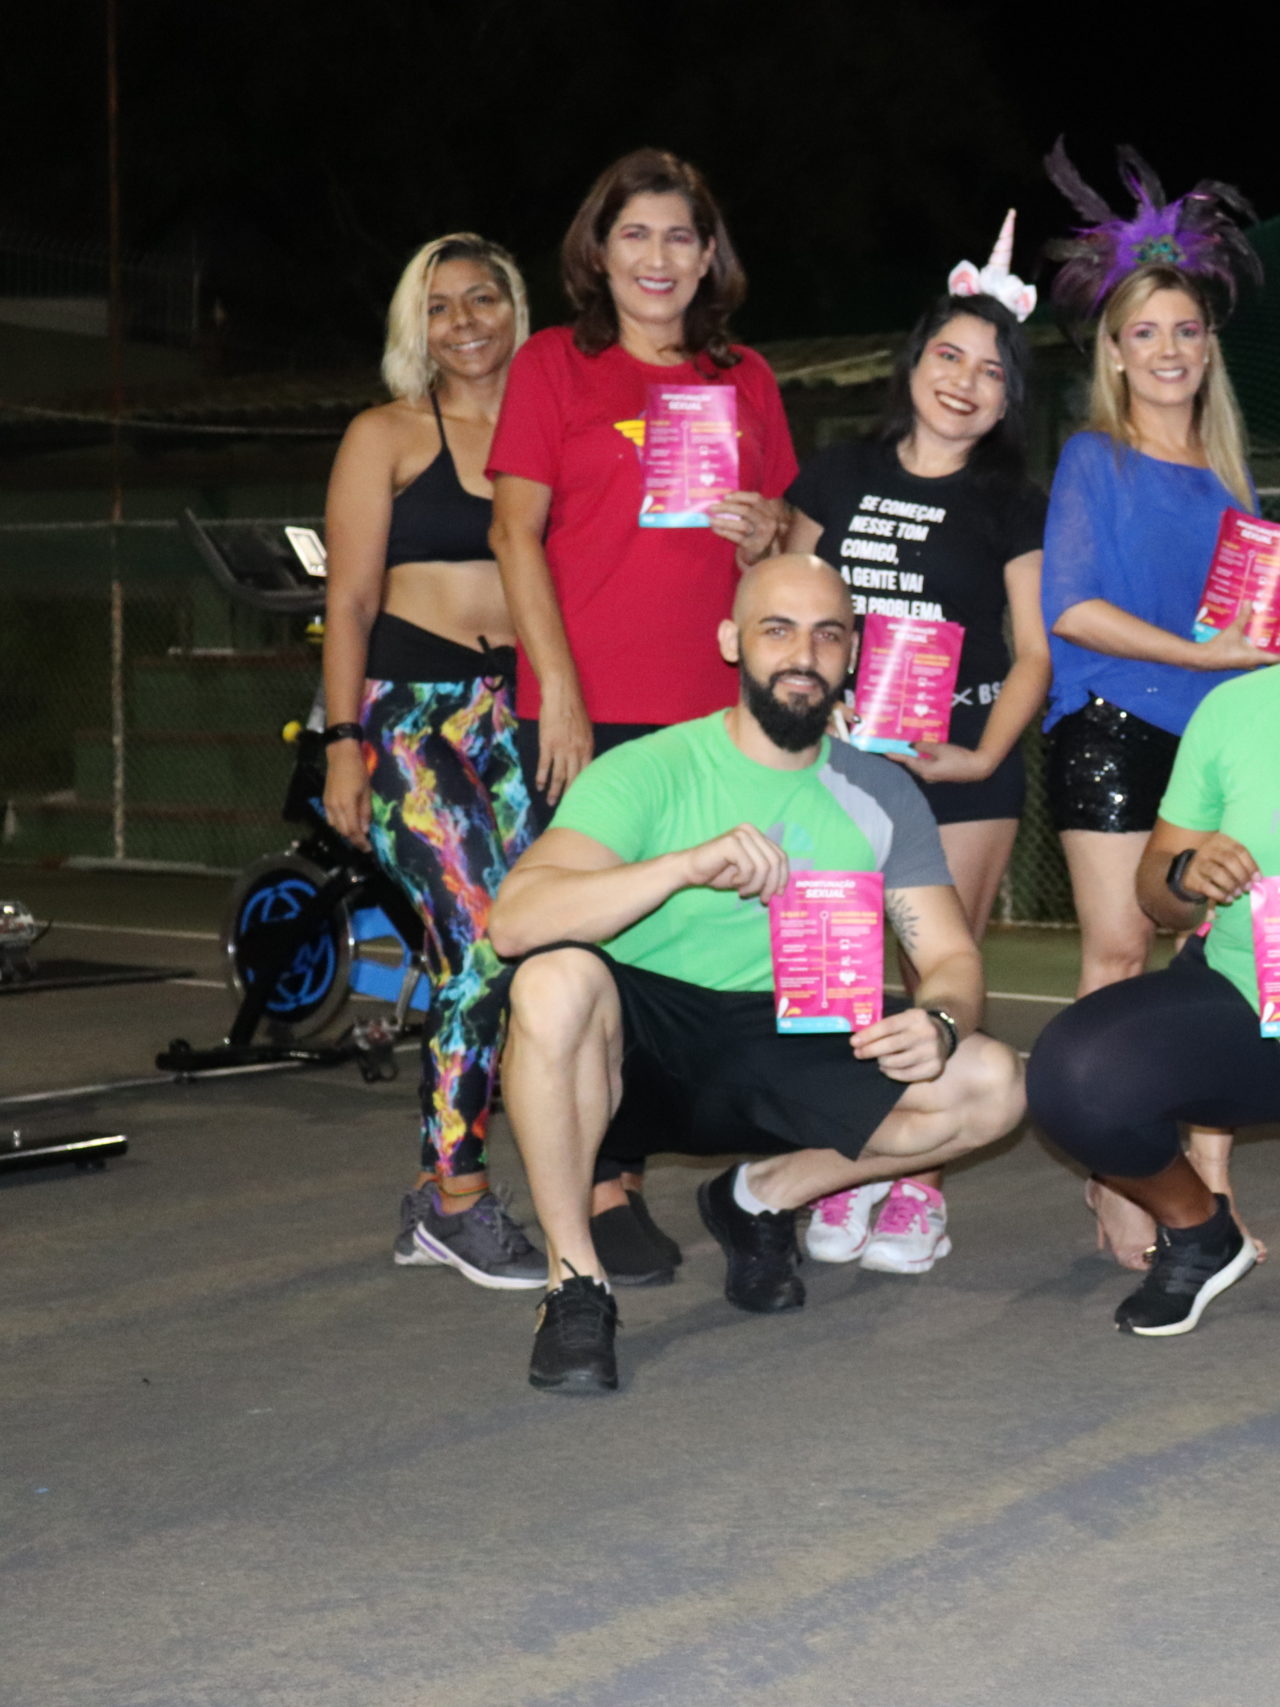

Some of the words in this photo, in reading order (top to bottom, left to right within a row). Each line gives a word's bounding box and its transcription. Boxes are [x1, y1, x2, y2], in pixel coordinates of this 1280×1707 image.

[859, 495, 881, 511] SE
[878, 499, 946, 524] COMEÇAR
[848, 515, 897, 537] NESSE
[896, 521, 930, 542] TOM
[840, 538, 900, 565] COMIGO,
[852, 566, 898, 591] GENTE
[899, 570, 924, 594] VAI
[805, 888, 846, 898] SEXUAL
